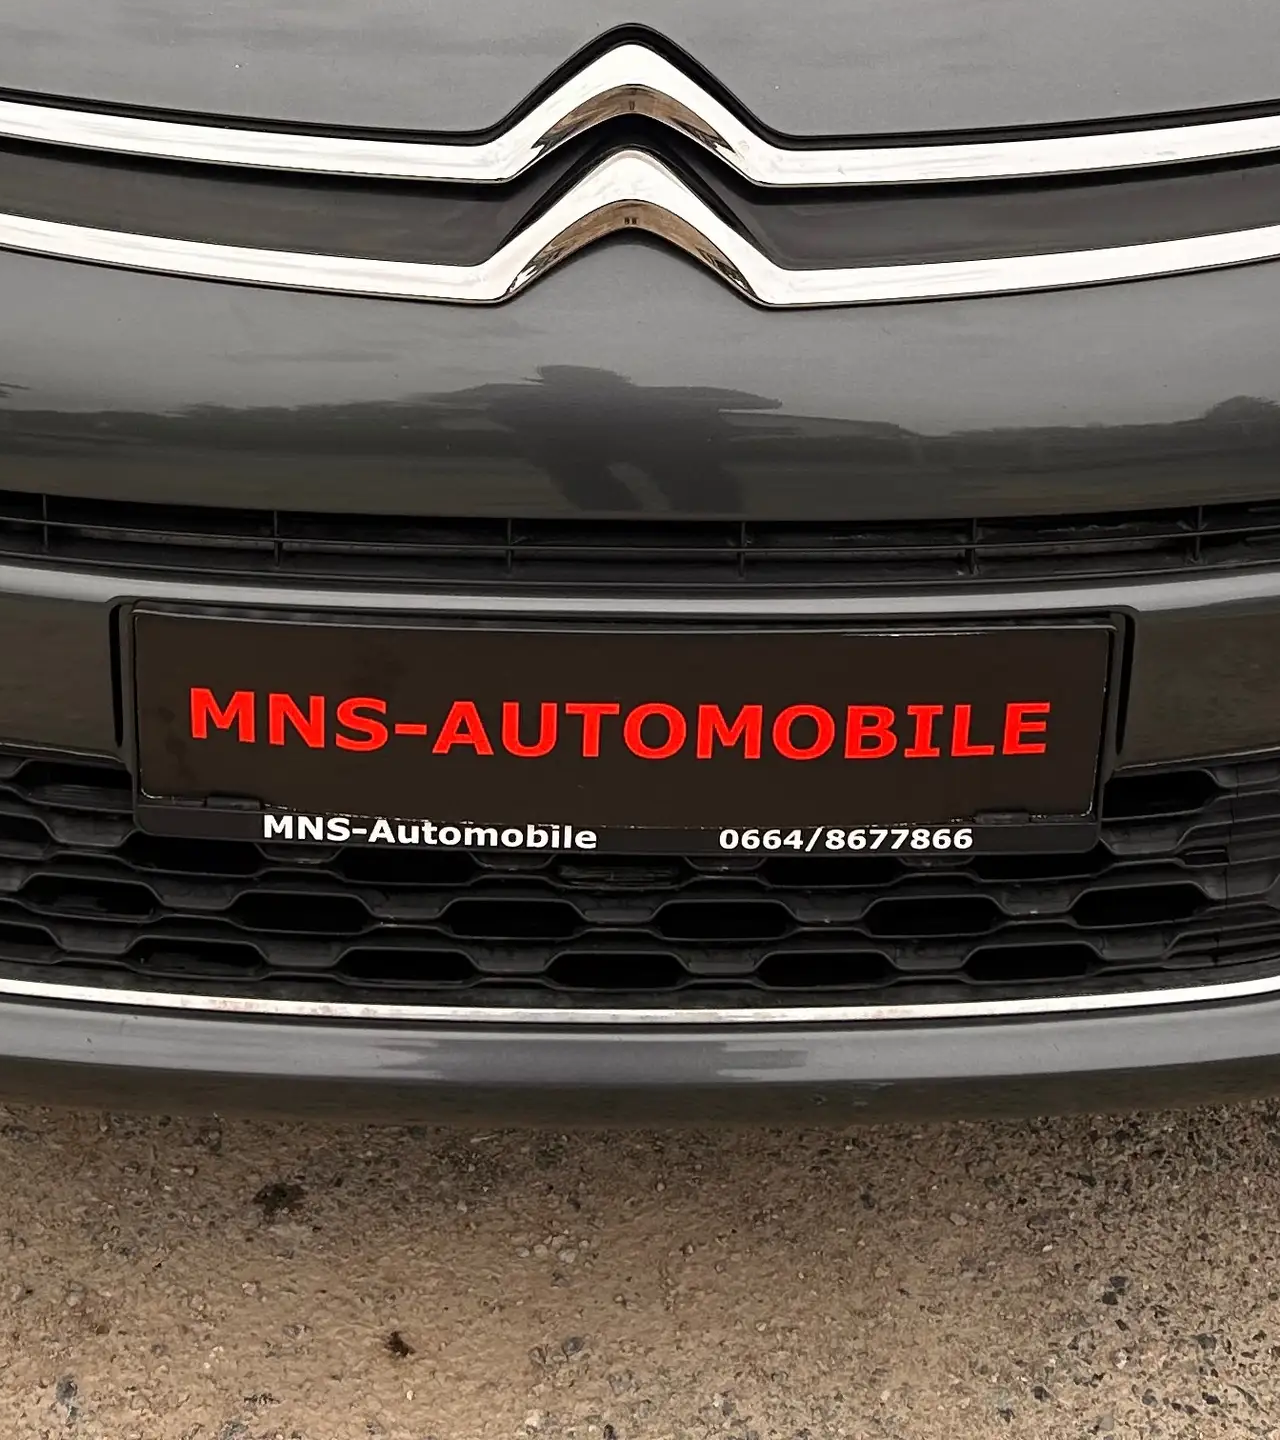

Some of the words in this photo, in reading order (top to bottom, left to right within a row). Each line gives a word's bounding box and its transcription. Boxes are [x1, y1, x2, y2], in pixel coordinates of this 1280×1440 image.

[189, 686, 1052, 762] MNS-AUTOMOBILE
[262, 813, 598, 850] MNS-Automobile
[718, 825, 974, 853] 0664/8677866
